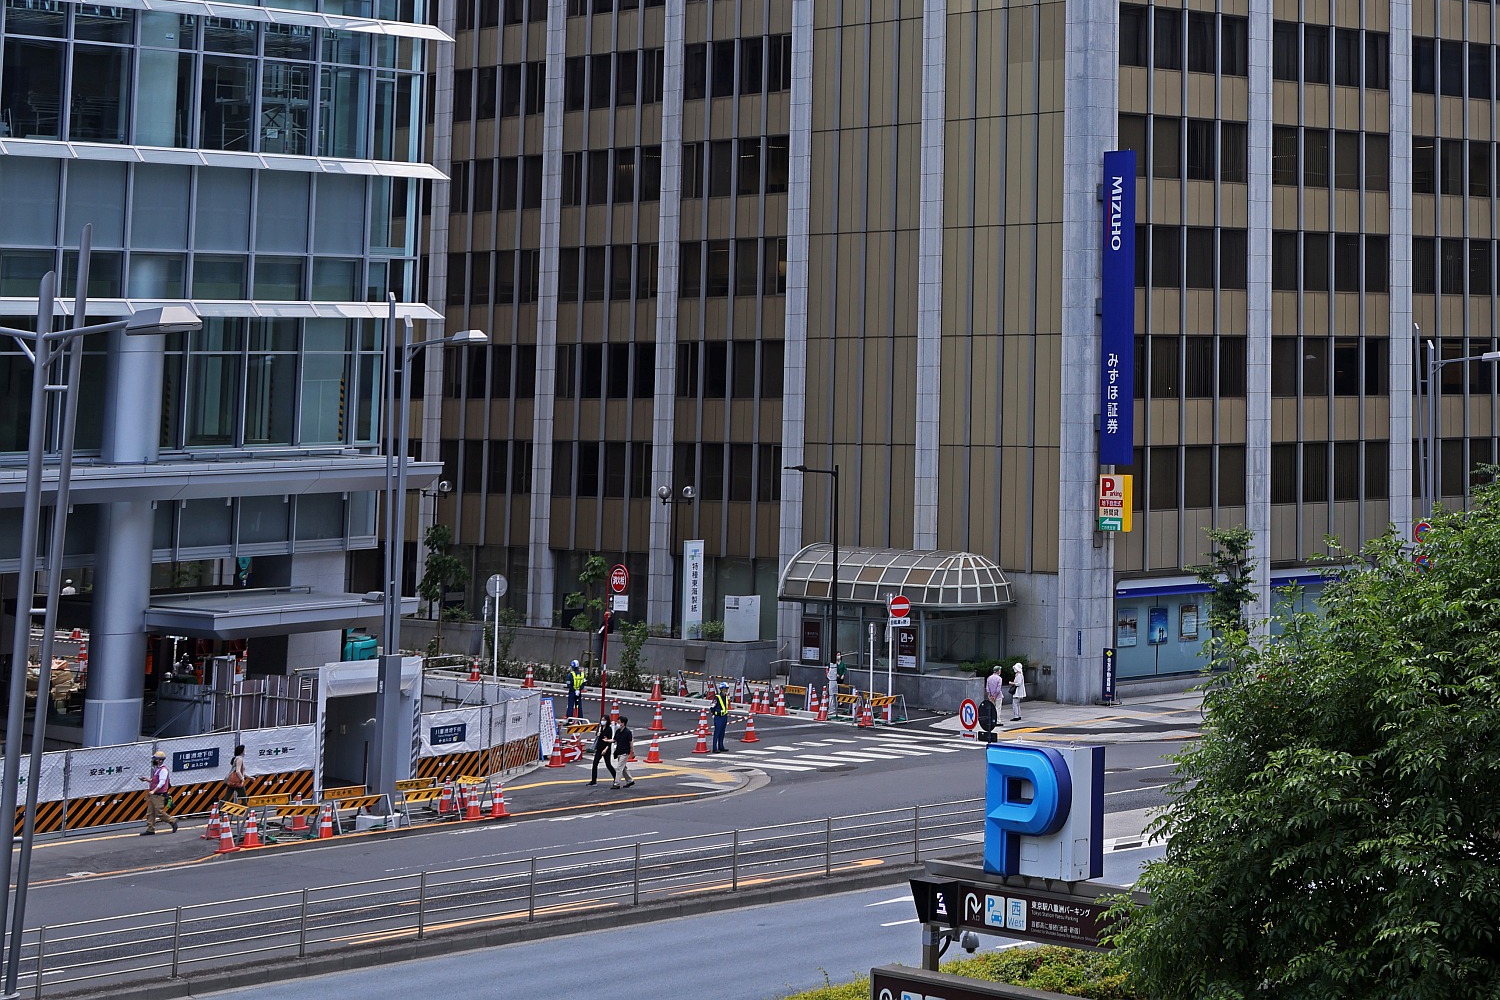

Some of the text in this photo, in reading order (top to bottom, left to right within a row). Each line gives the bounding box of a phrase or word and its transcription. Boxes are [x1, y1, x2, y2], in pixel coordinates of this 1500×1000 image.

[1111, 176, 1123, 252] MIZUHO
[1107, 353, 1119, 434] みずほ証券
[690, 562, 699, 613] 特種東海製紙
[984, 743, 1072, 877] P
[987, 898, 995, 912] P
[1008, 916, 1025, 928] West
[1012, 901, 1022, 917] 西
